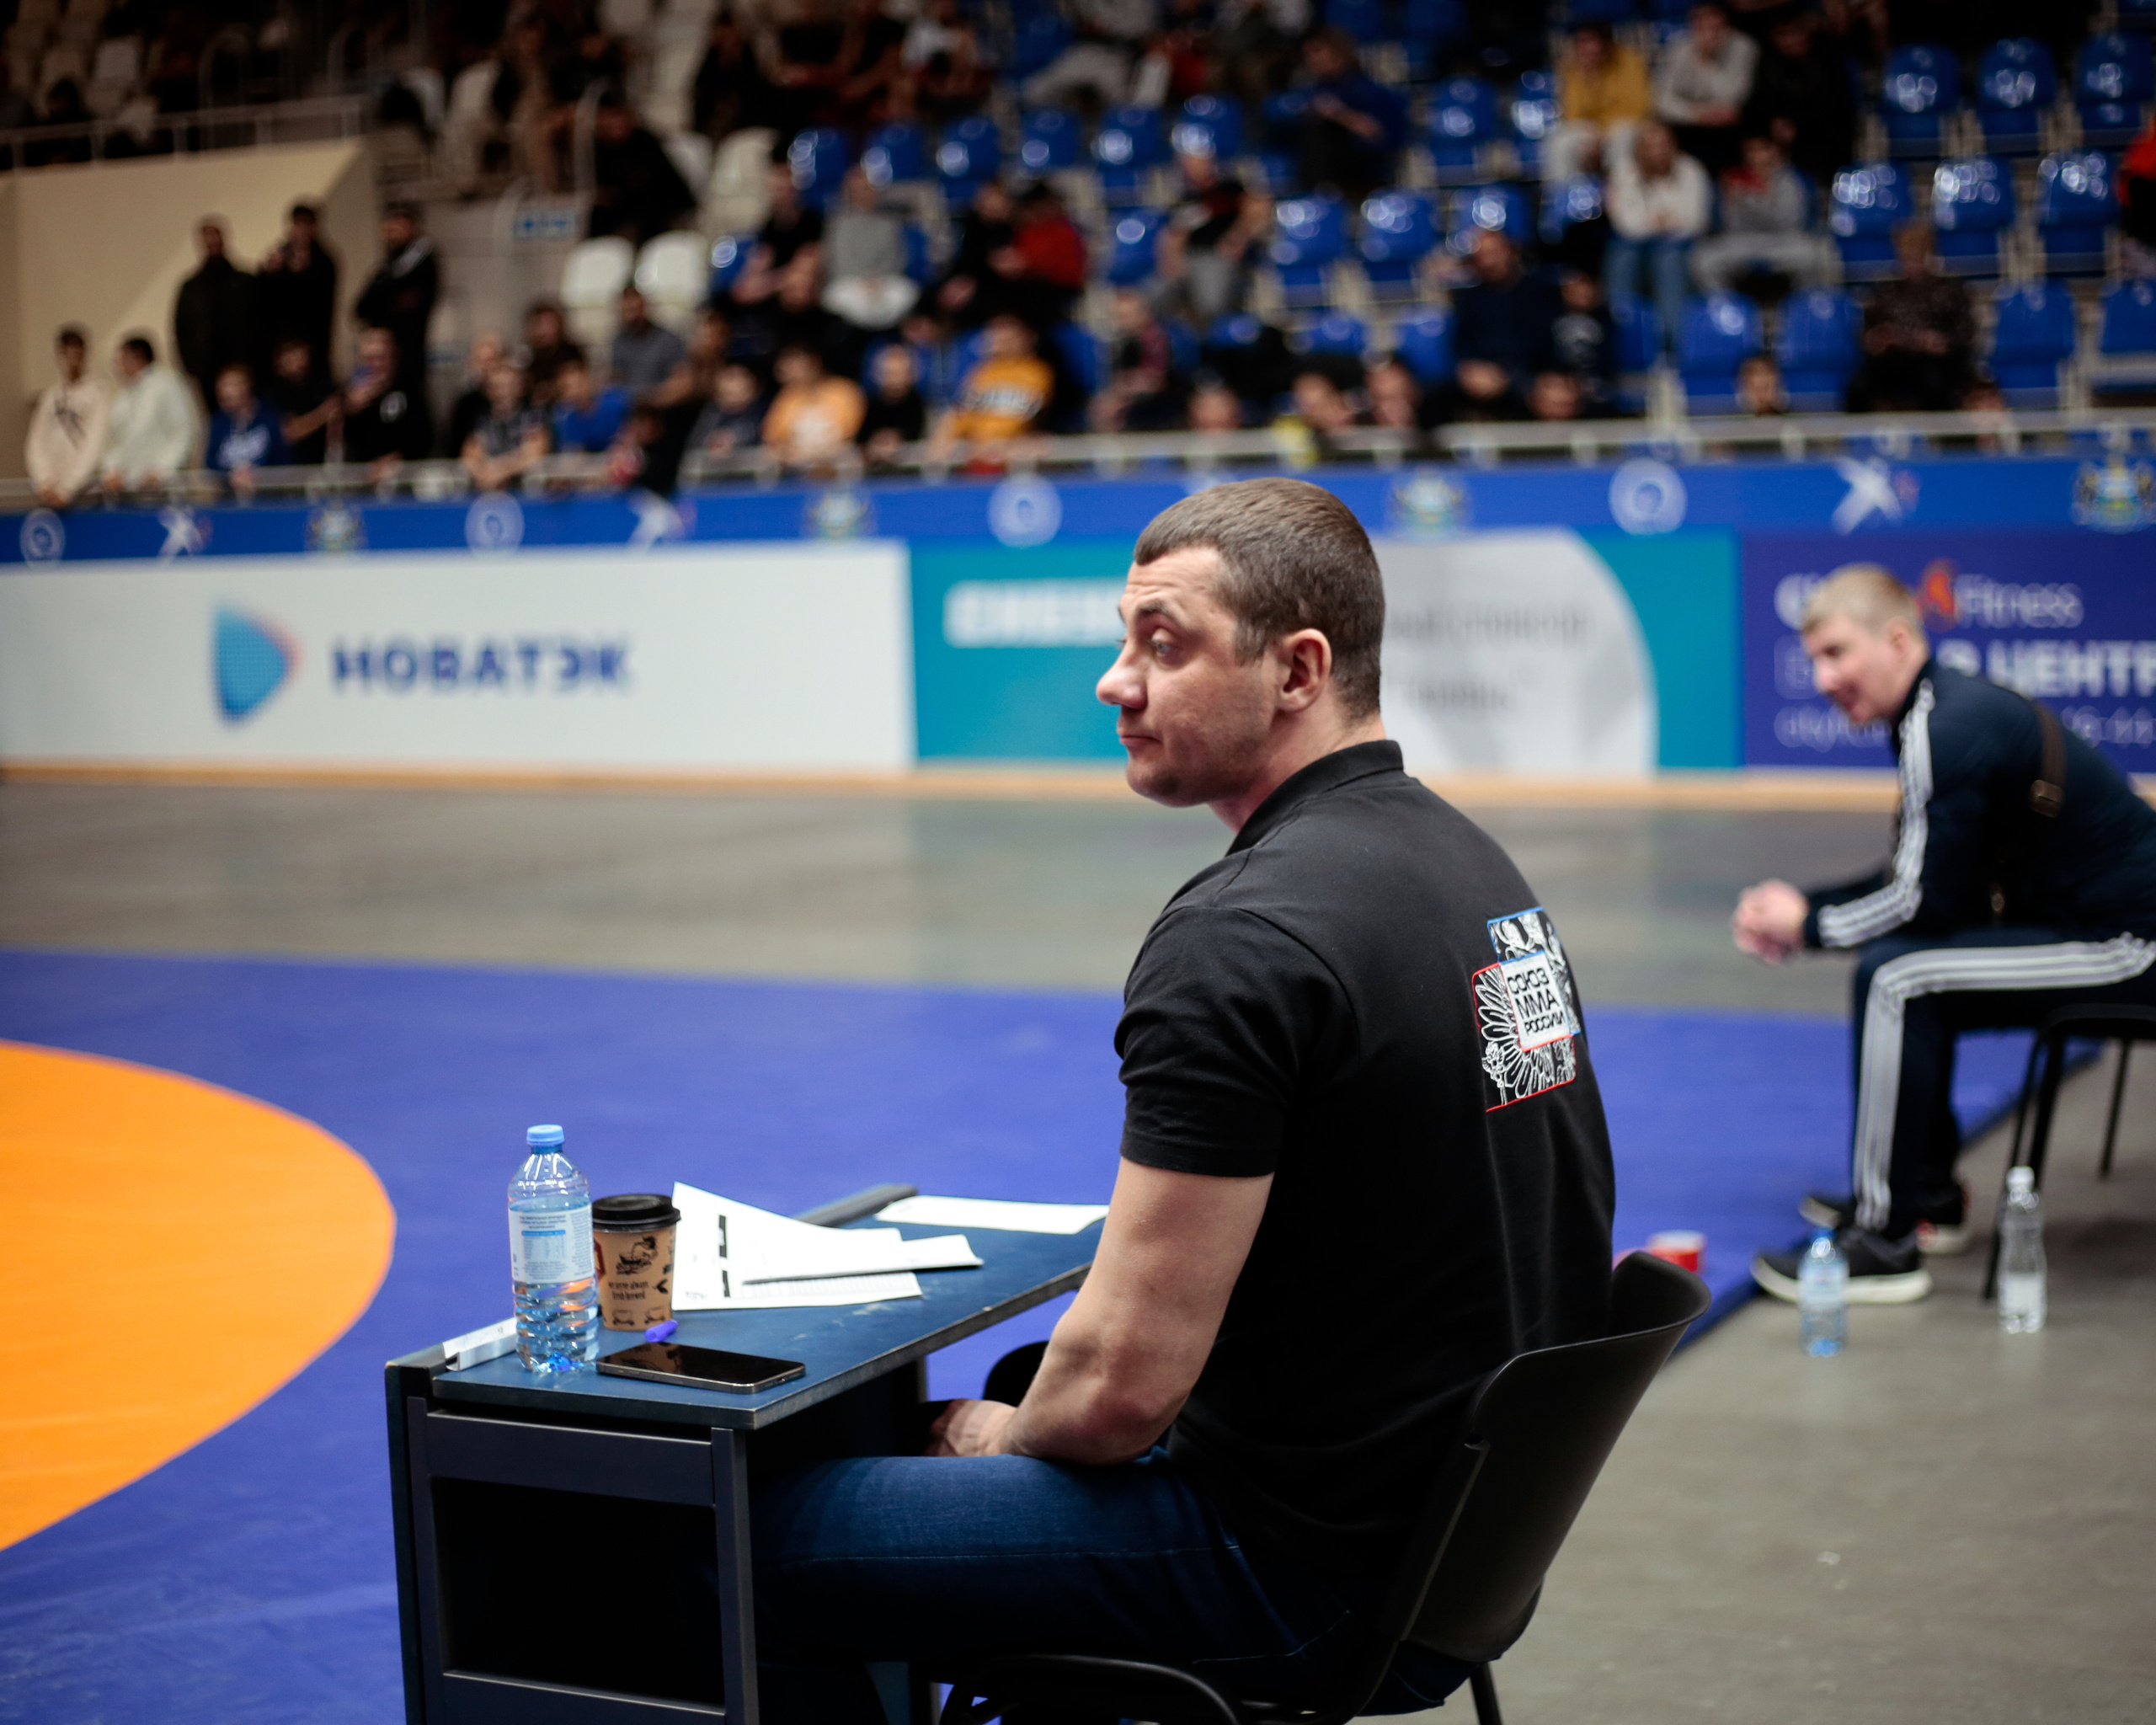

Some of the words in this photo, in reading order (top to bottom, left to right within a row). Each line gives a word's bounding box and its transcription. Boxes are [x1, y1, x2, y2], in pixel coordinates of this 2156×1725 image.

[332, 635, 633, 694] НОВАТЭК
[1508, 968, 1550, 995] СОЮЗ
[1514, 989, 1561, 1018] ММА
[1524, 1010, 1566, 1037] РОССИИ
